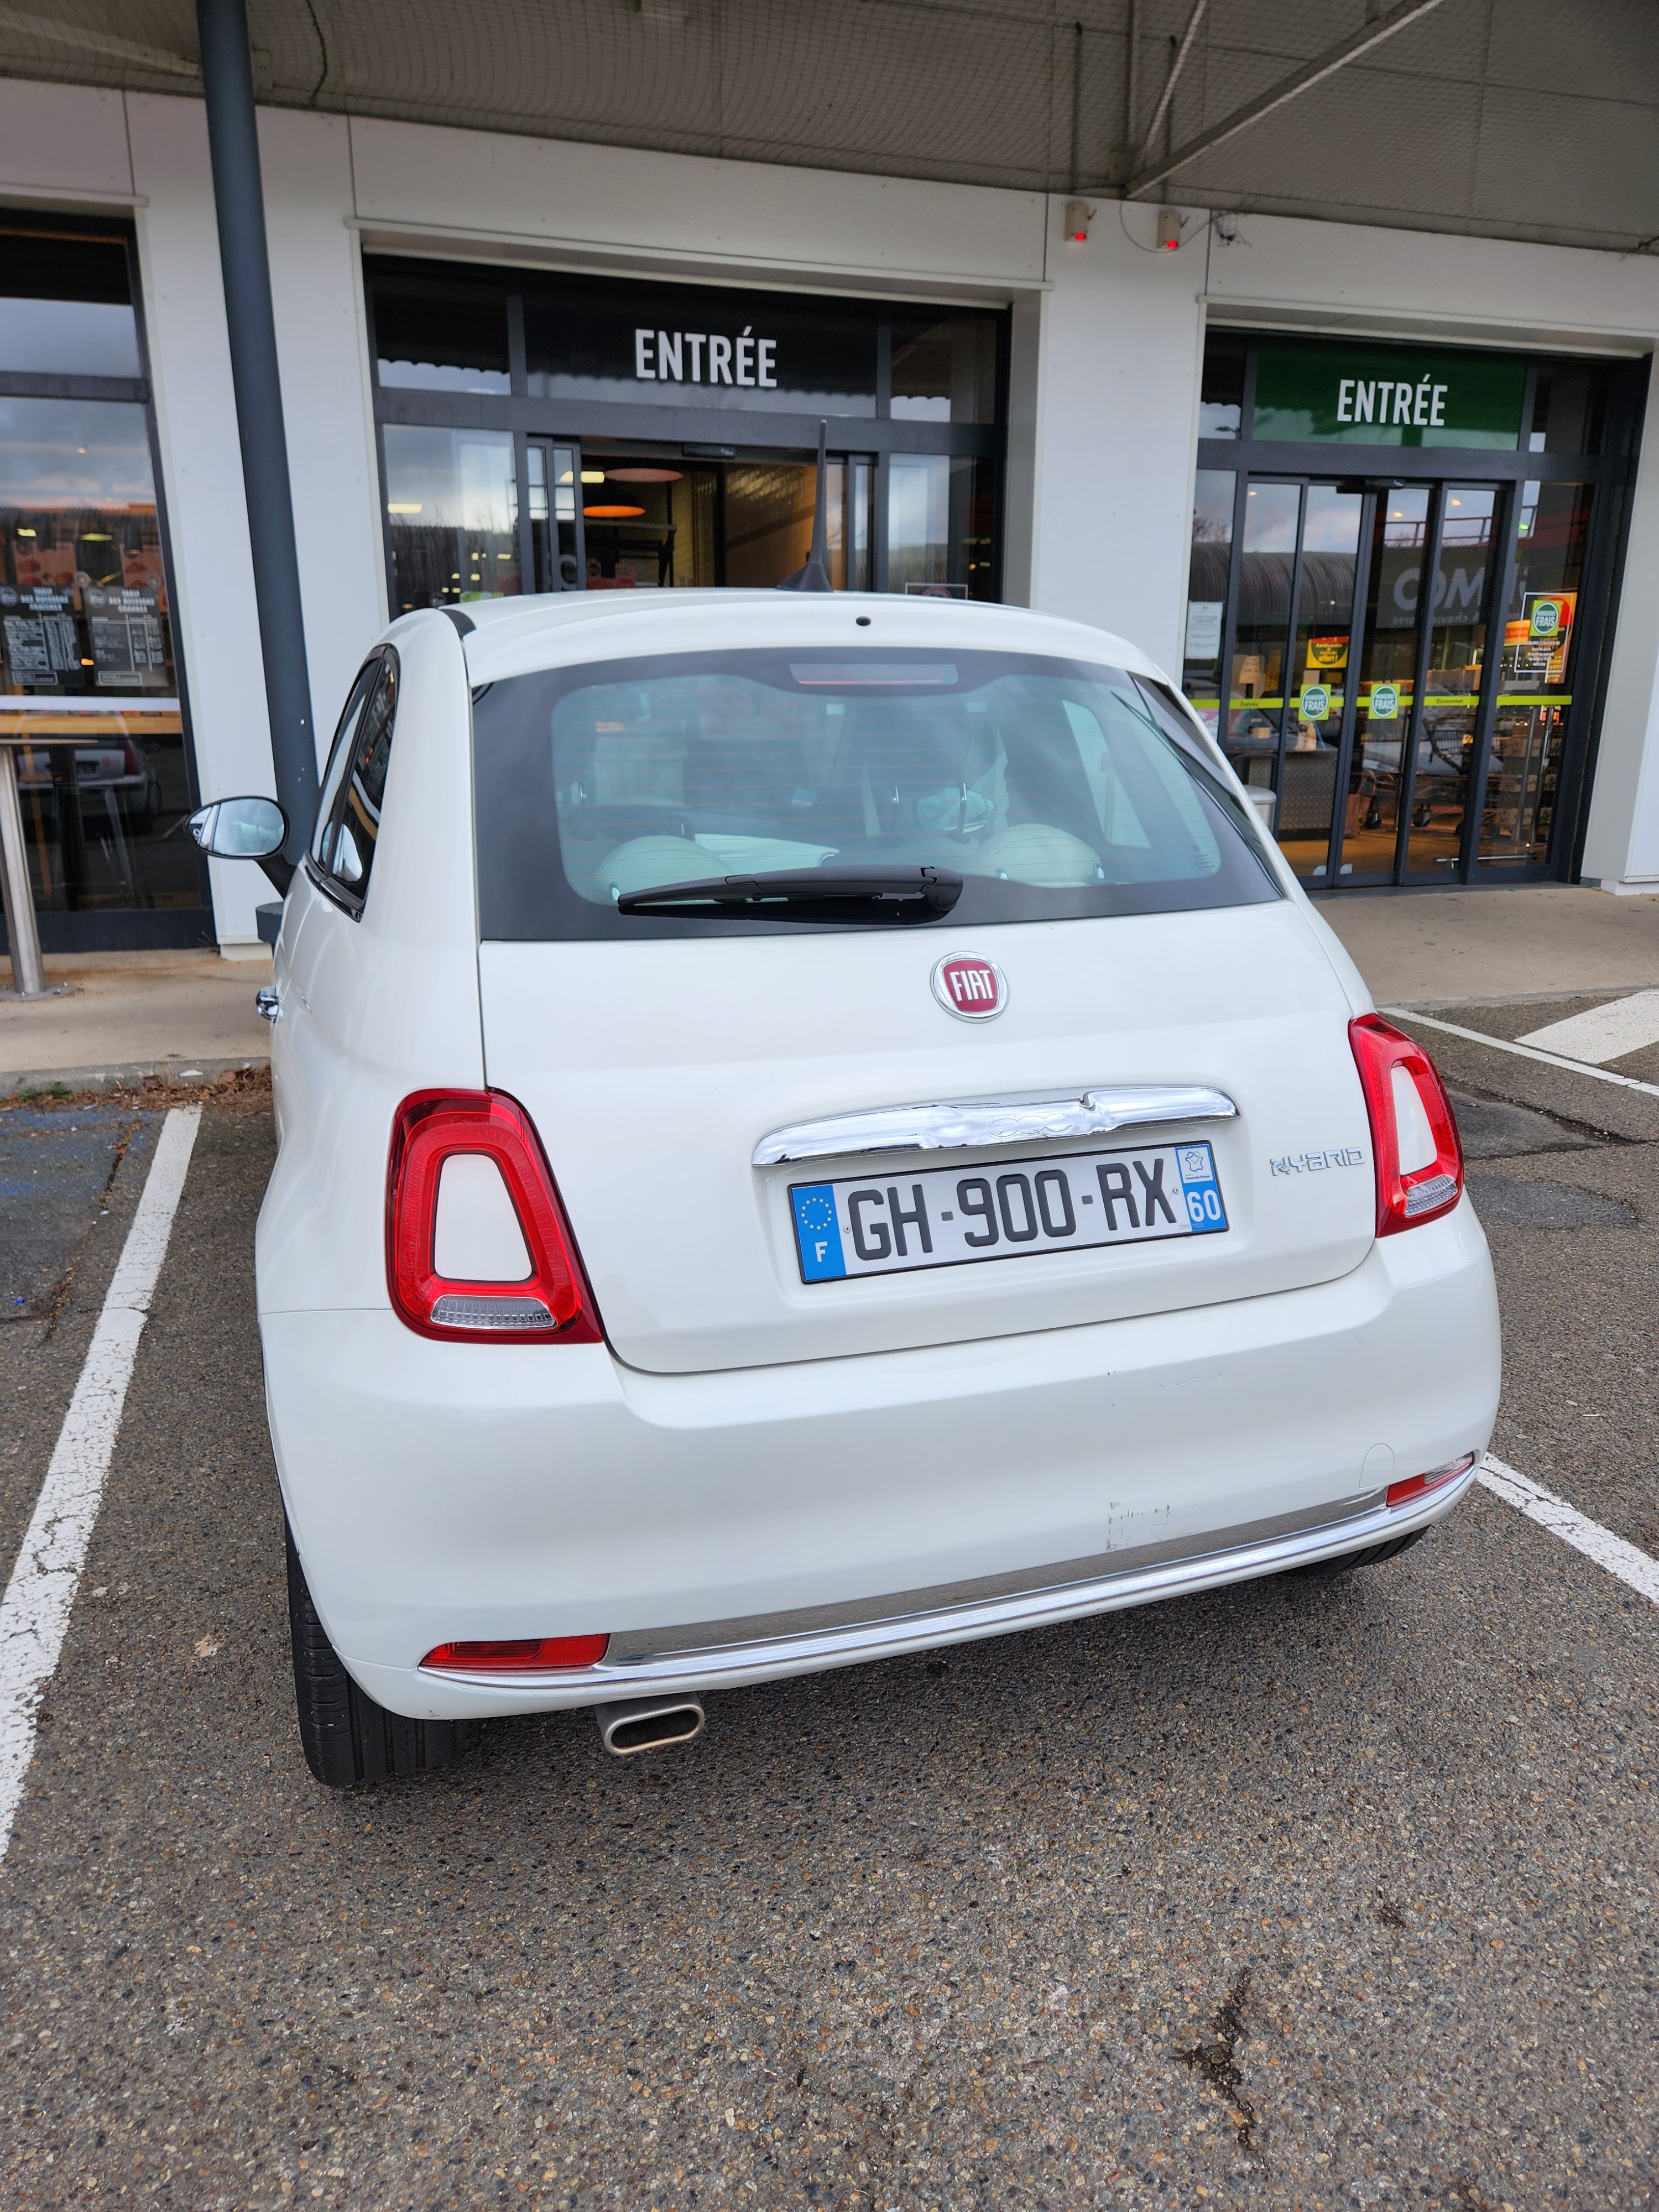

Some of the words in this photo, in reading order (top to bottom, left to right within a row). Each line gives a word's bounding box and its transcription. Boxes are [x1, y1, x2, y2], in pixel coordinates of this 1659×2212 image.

[635, 325, 778, 387] ENTRÉE
[1337, 374, 1448, 426] ENTRÉE
[1536, 616, 1555, 627] FRAIS
[1305, 701, 1325, 711] FRAIS
[1375, 700, 1394, 709] FRAIS
[950, 970, 993, 1001] FIAT
[1270, 1147, 1366, 1176] HYBRID
[1187, 1190, 1221, 1222] 60
[815, 1241, 828, 1263] F
